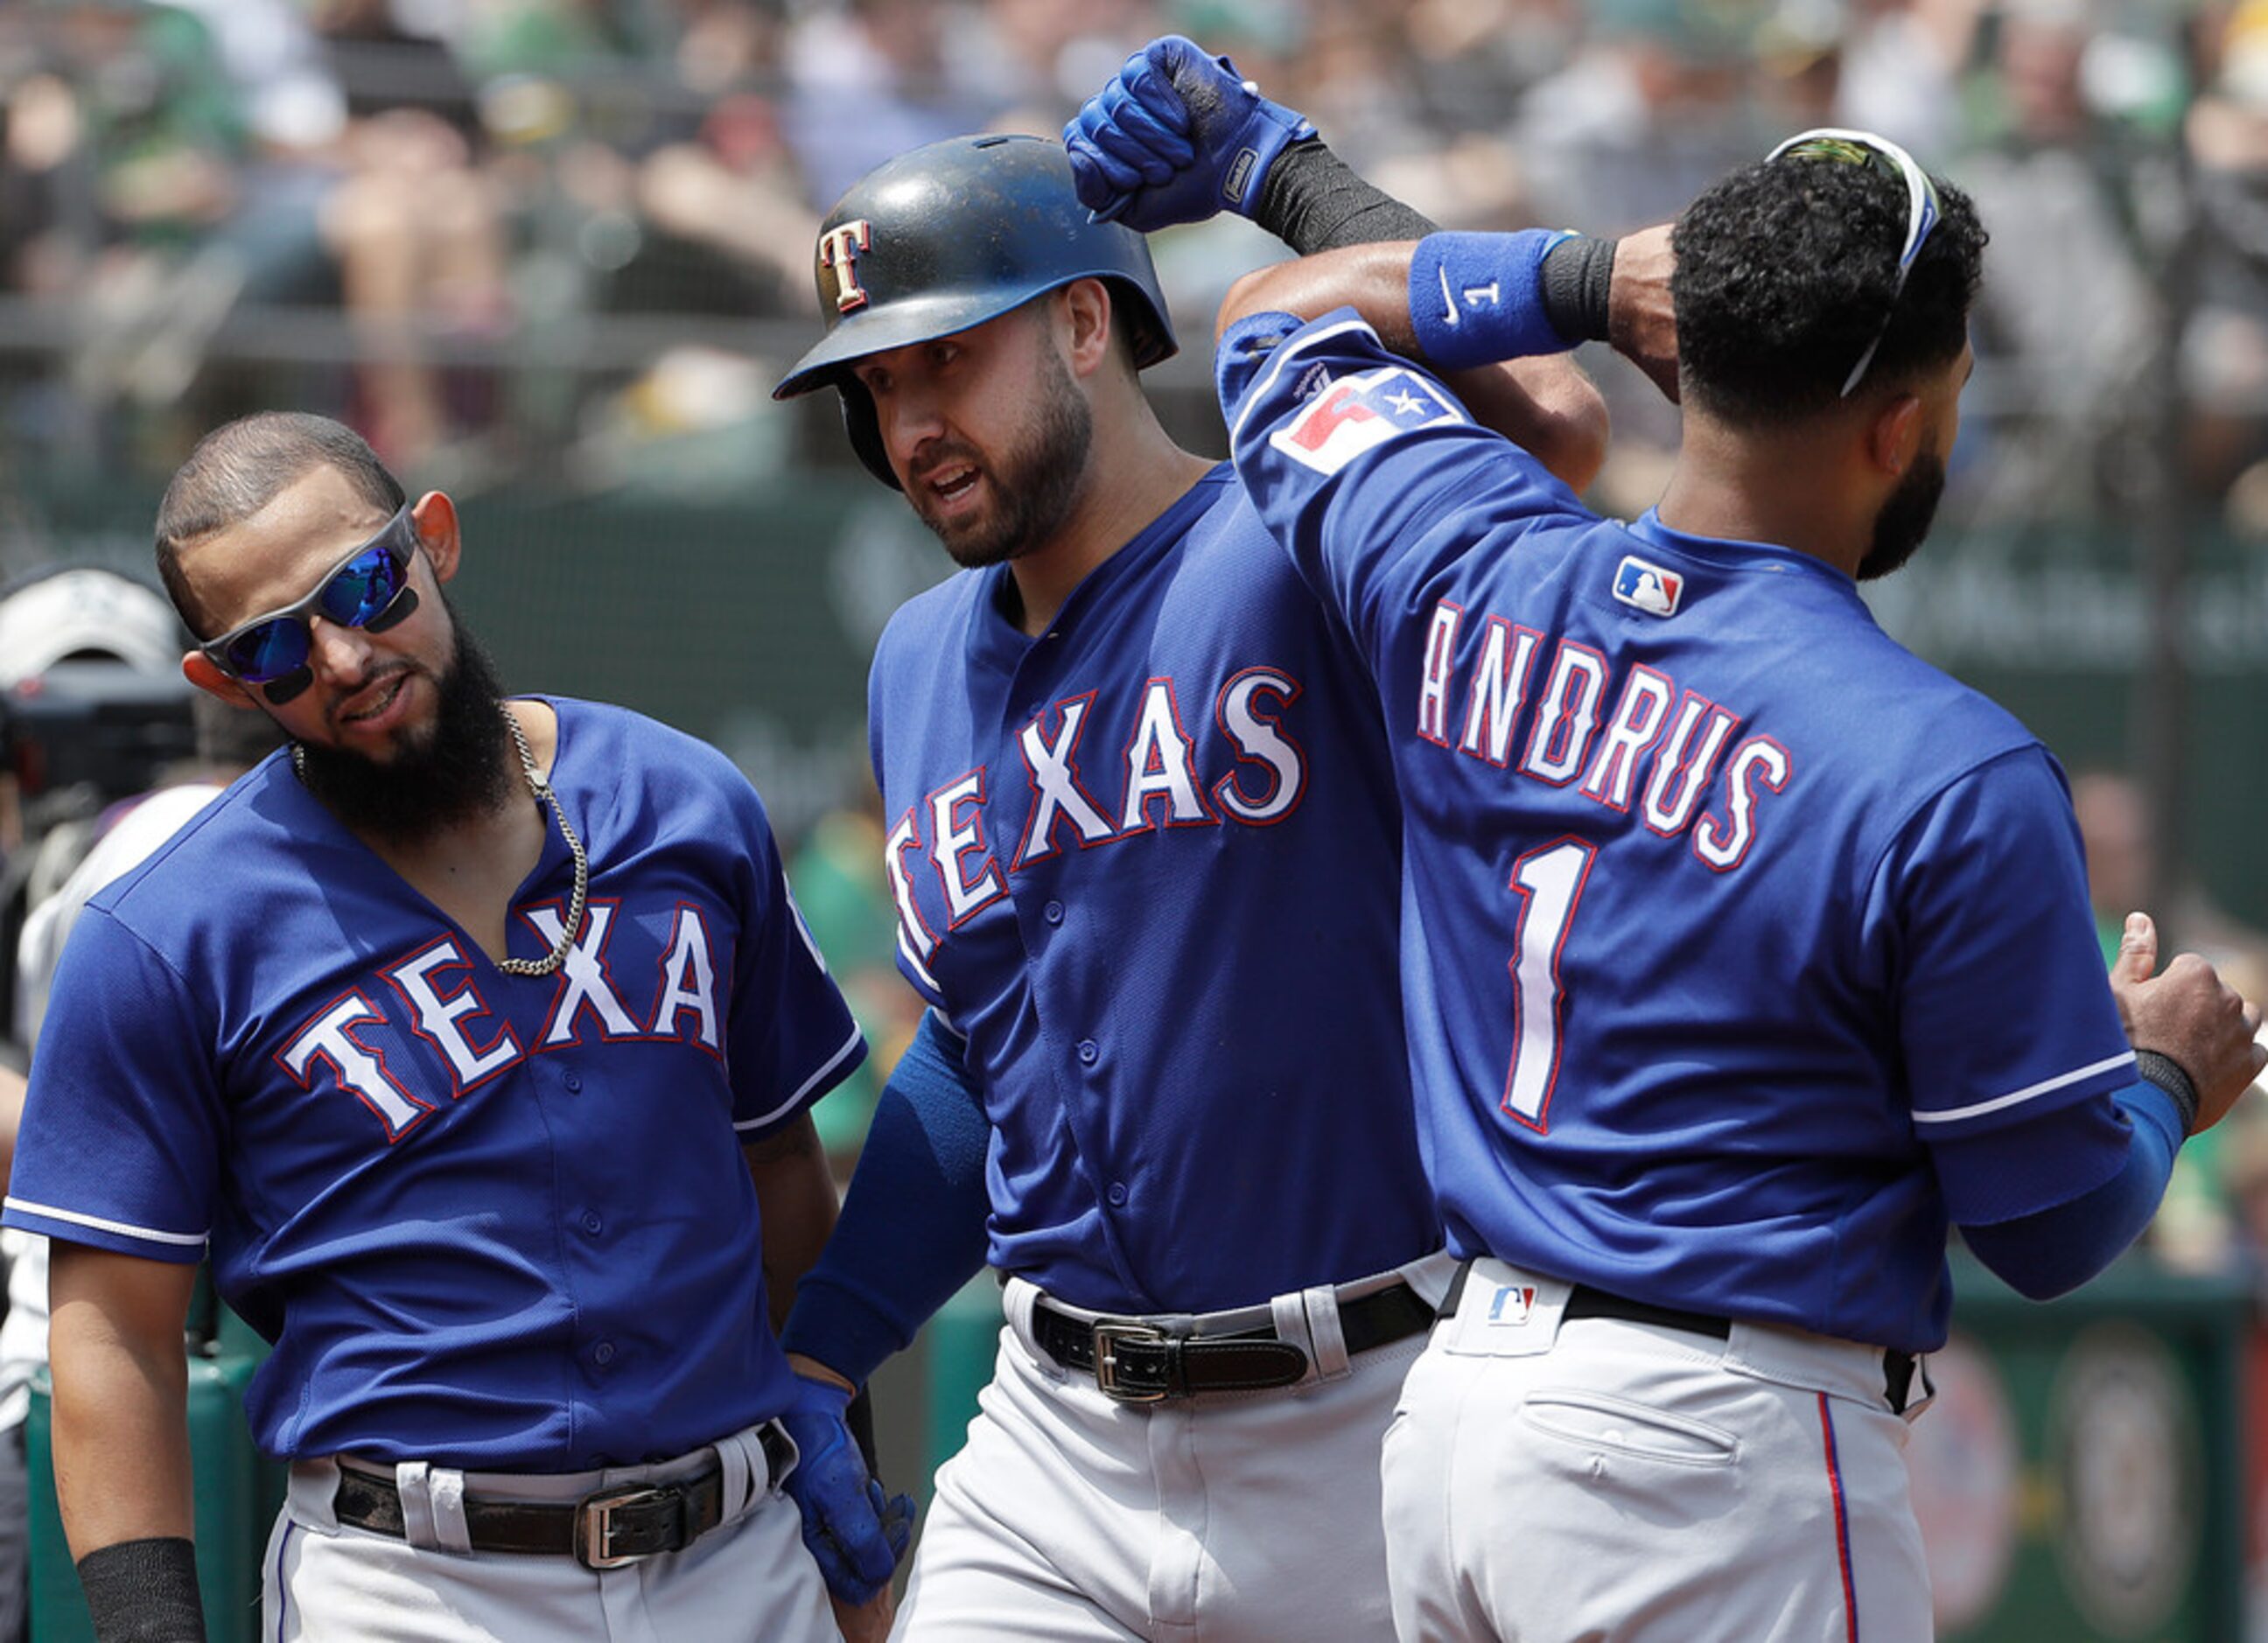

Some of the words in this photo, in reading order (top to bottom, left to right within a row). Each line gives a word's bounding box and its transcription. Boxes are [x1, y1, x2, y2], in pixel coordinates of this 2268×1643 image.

[819, 219, 871, 313] T
[1463, 283, 1499, 305] 1
[885, 667, 1307, 968] TEXAS
[1417, 599, 1792, 871] ANDRUS
[272, 898, 734, 1144] TEXA
[1501, 834, 1598, 1136] 1
